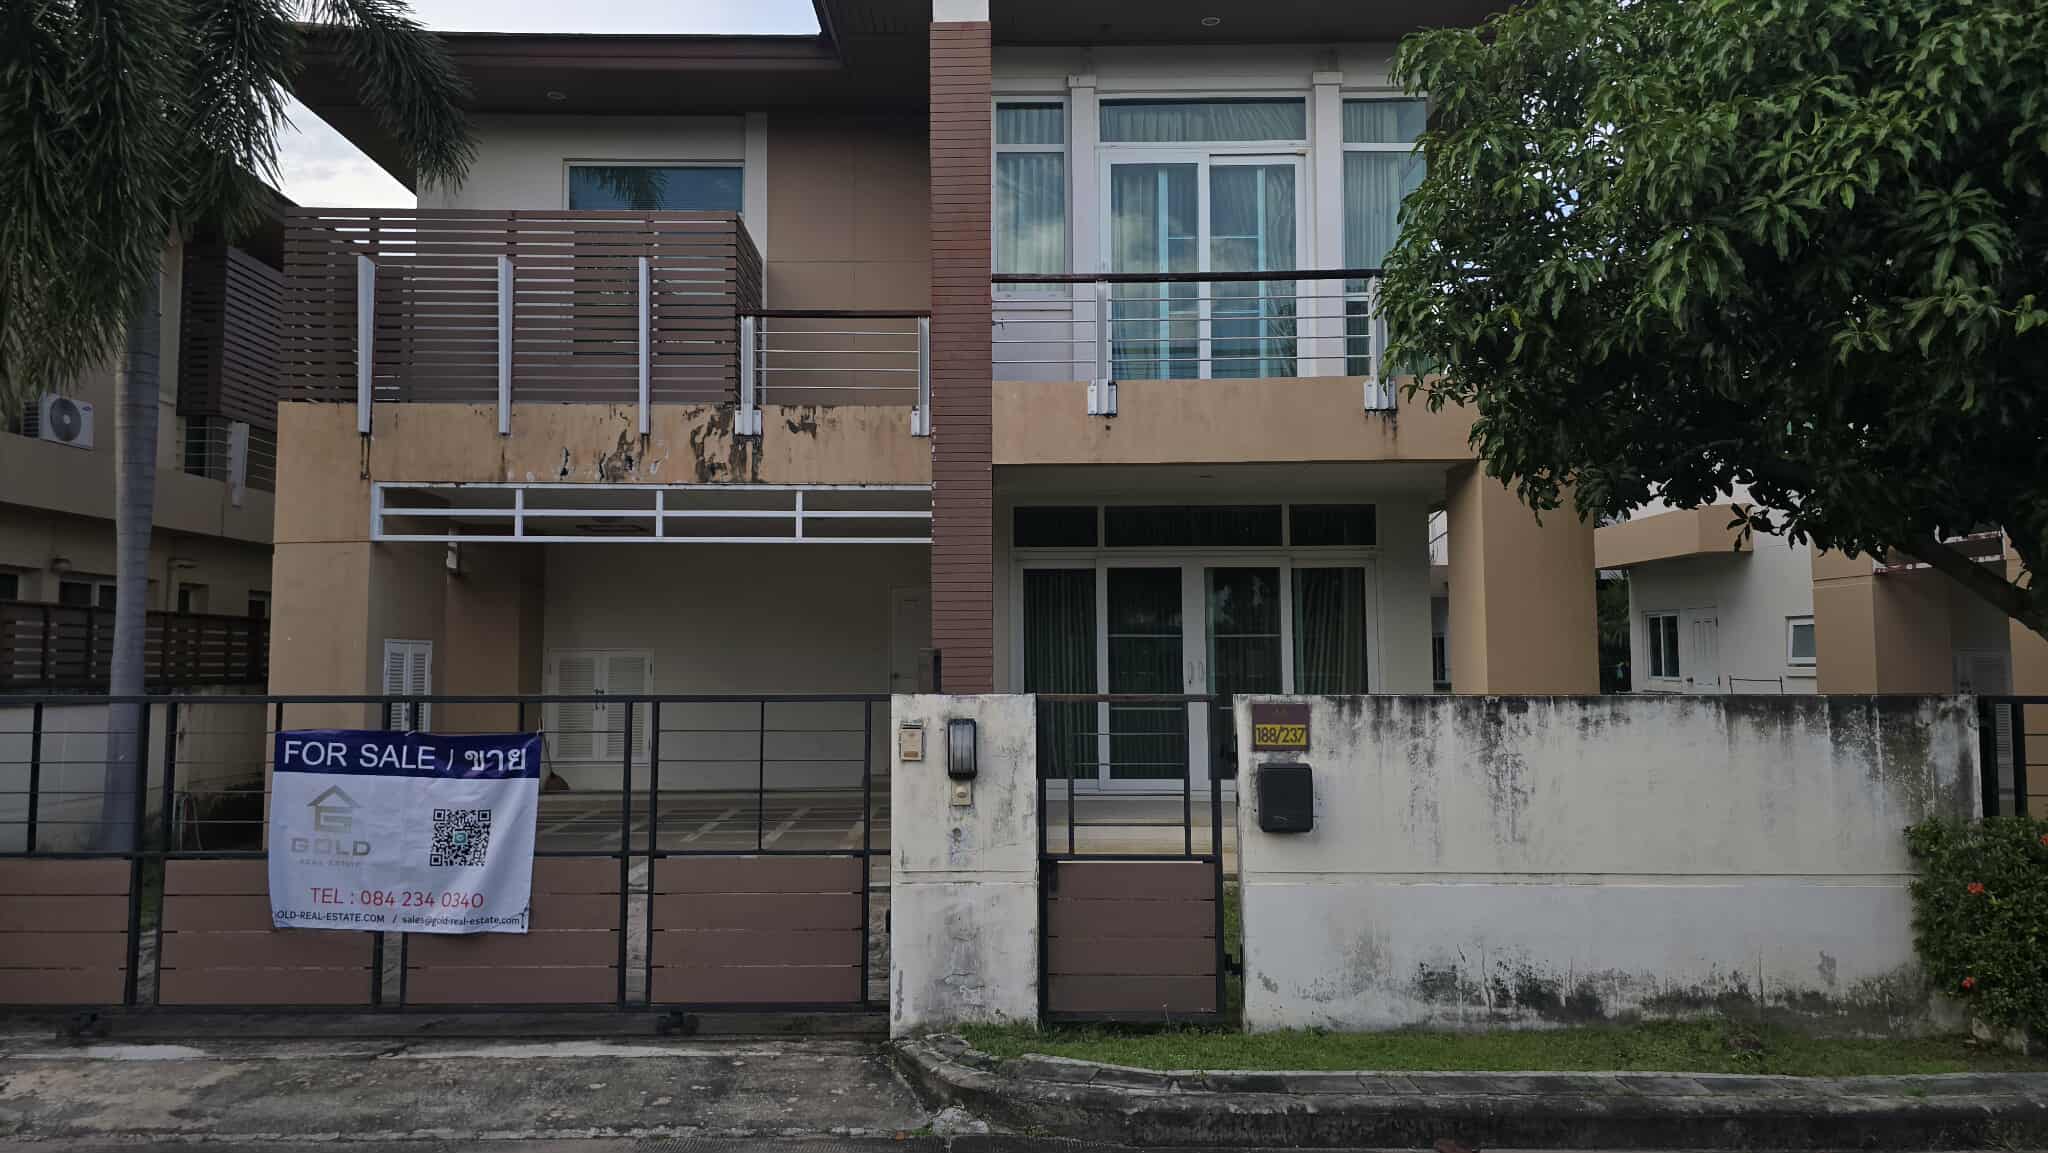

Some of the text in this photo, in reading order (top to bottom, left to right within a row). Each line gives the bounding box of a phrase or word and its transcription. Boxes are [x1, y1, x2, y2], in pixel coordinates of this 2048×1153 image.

[1257, 727, 1304, 744] 188/237
[283, 740, 348, 767] FOR
[359, 743, 436, 770] SALE
[464, 747, 527, 771] ขาย
[290, 837, 372, 857] GOLD
[311, 887, 344, 905] TEL
[360, 889, 396, 906] 084
[402, 890, 435, 907] 234
[442, 891, 485, 908] 0340
